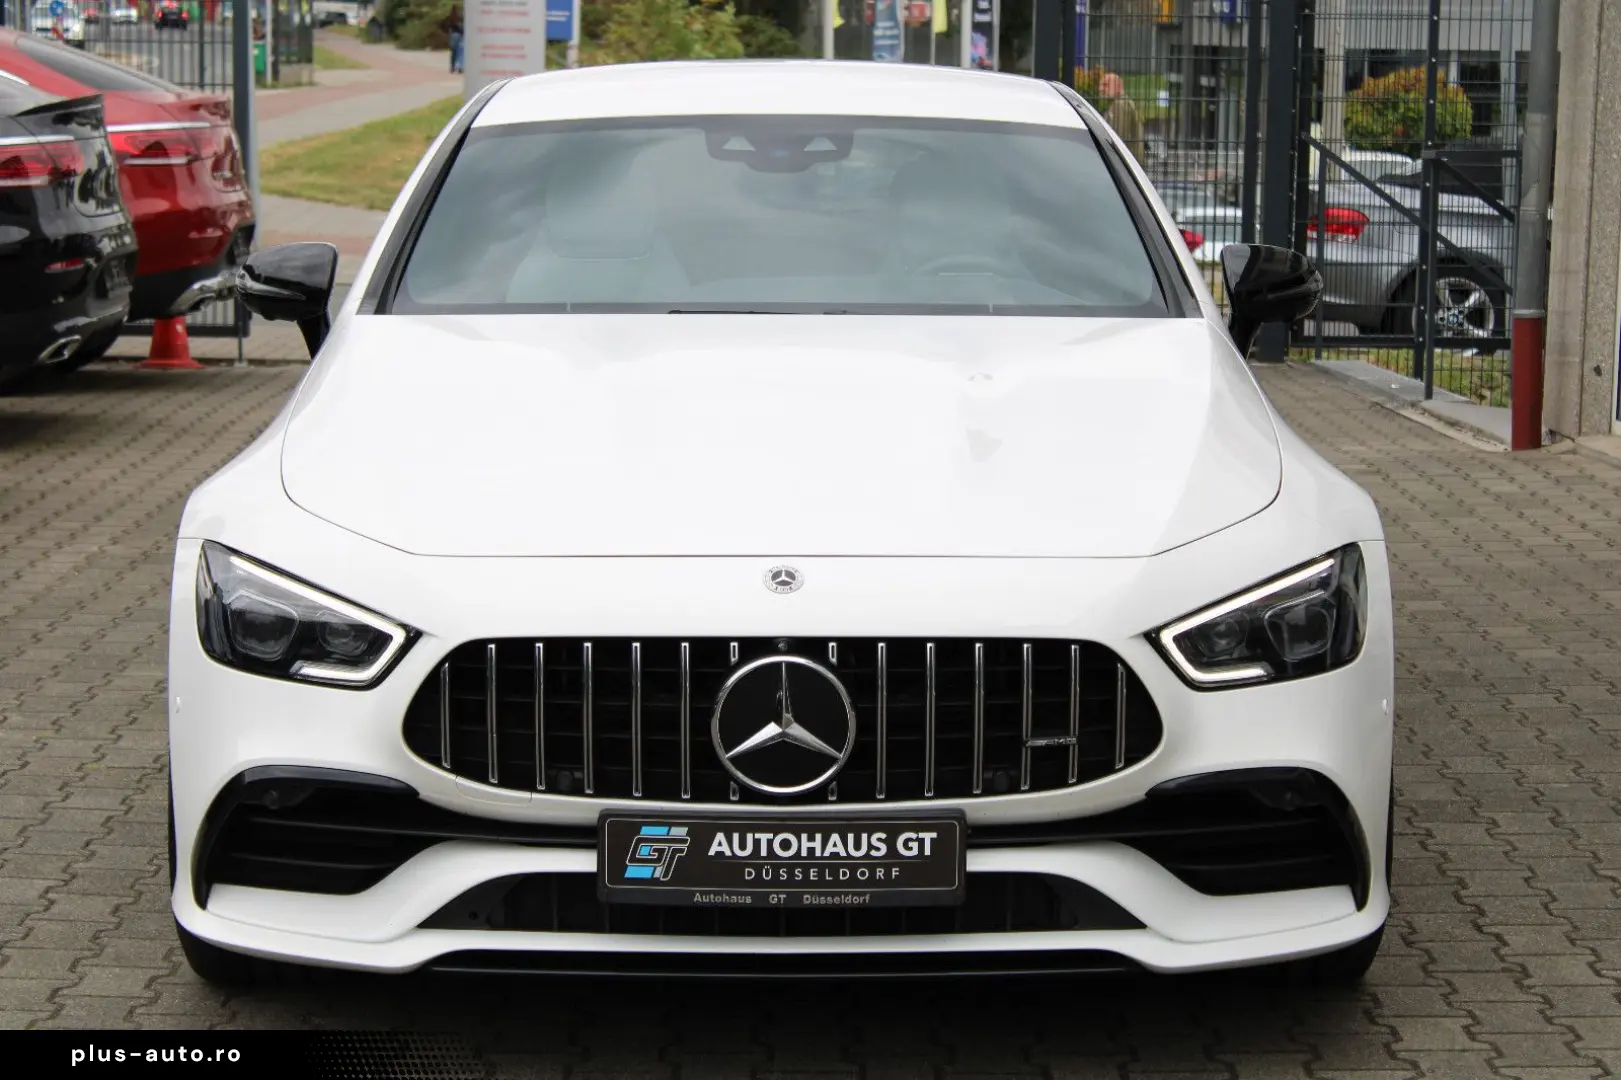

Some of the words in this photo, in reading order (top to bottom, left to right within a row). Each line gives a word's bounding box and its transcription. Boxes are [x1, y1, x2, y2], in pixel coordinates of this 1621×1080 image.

[708, 832, 888, 857] AUTOHAUS
[896, 832, 938, 857] GT
[745, 866, 901, 880] DÜSSELDORF
[694, 892, 752, 904] Autohaus
[769, 893, 787, 904] GT
[803, 892, 870, 904] Düsseldorf
